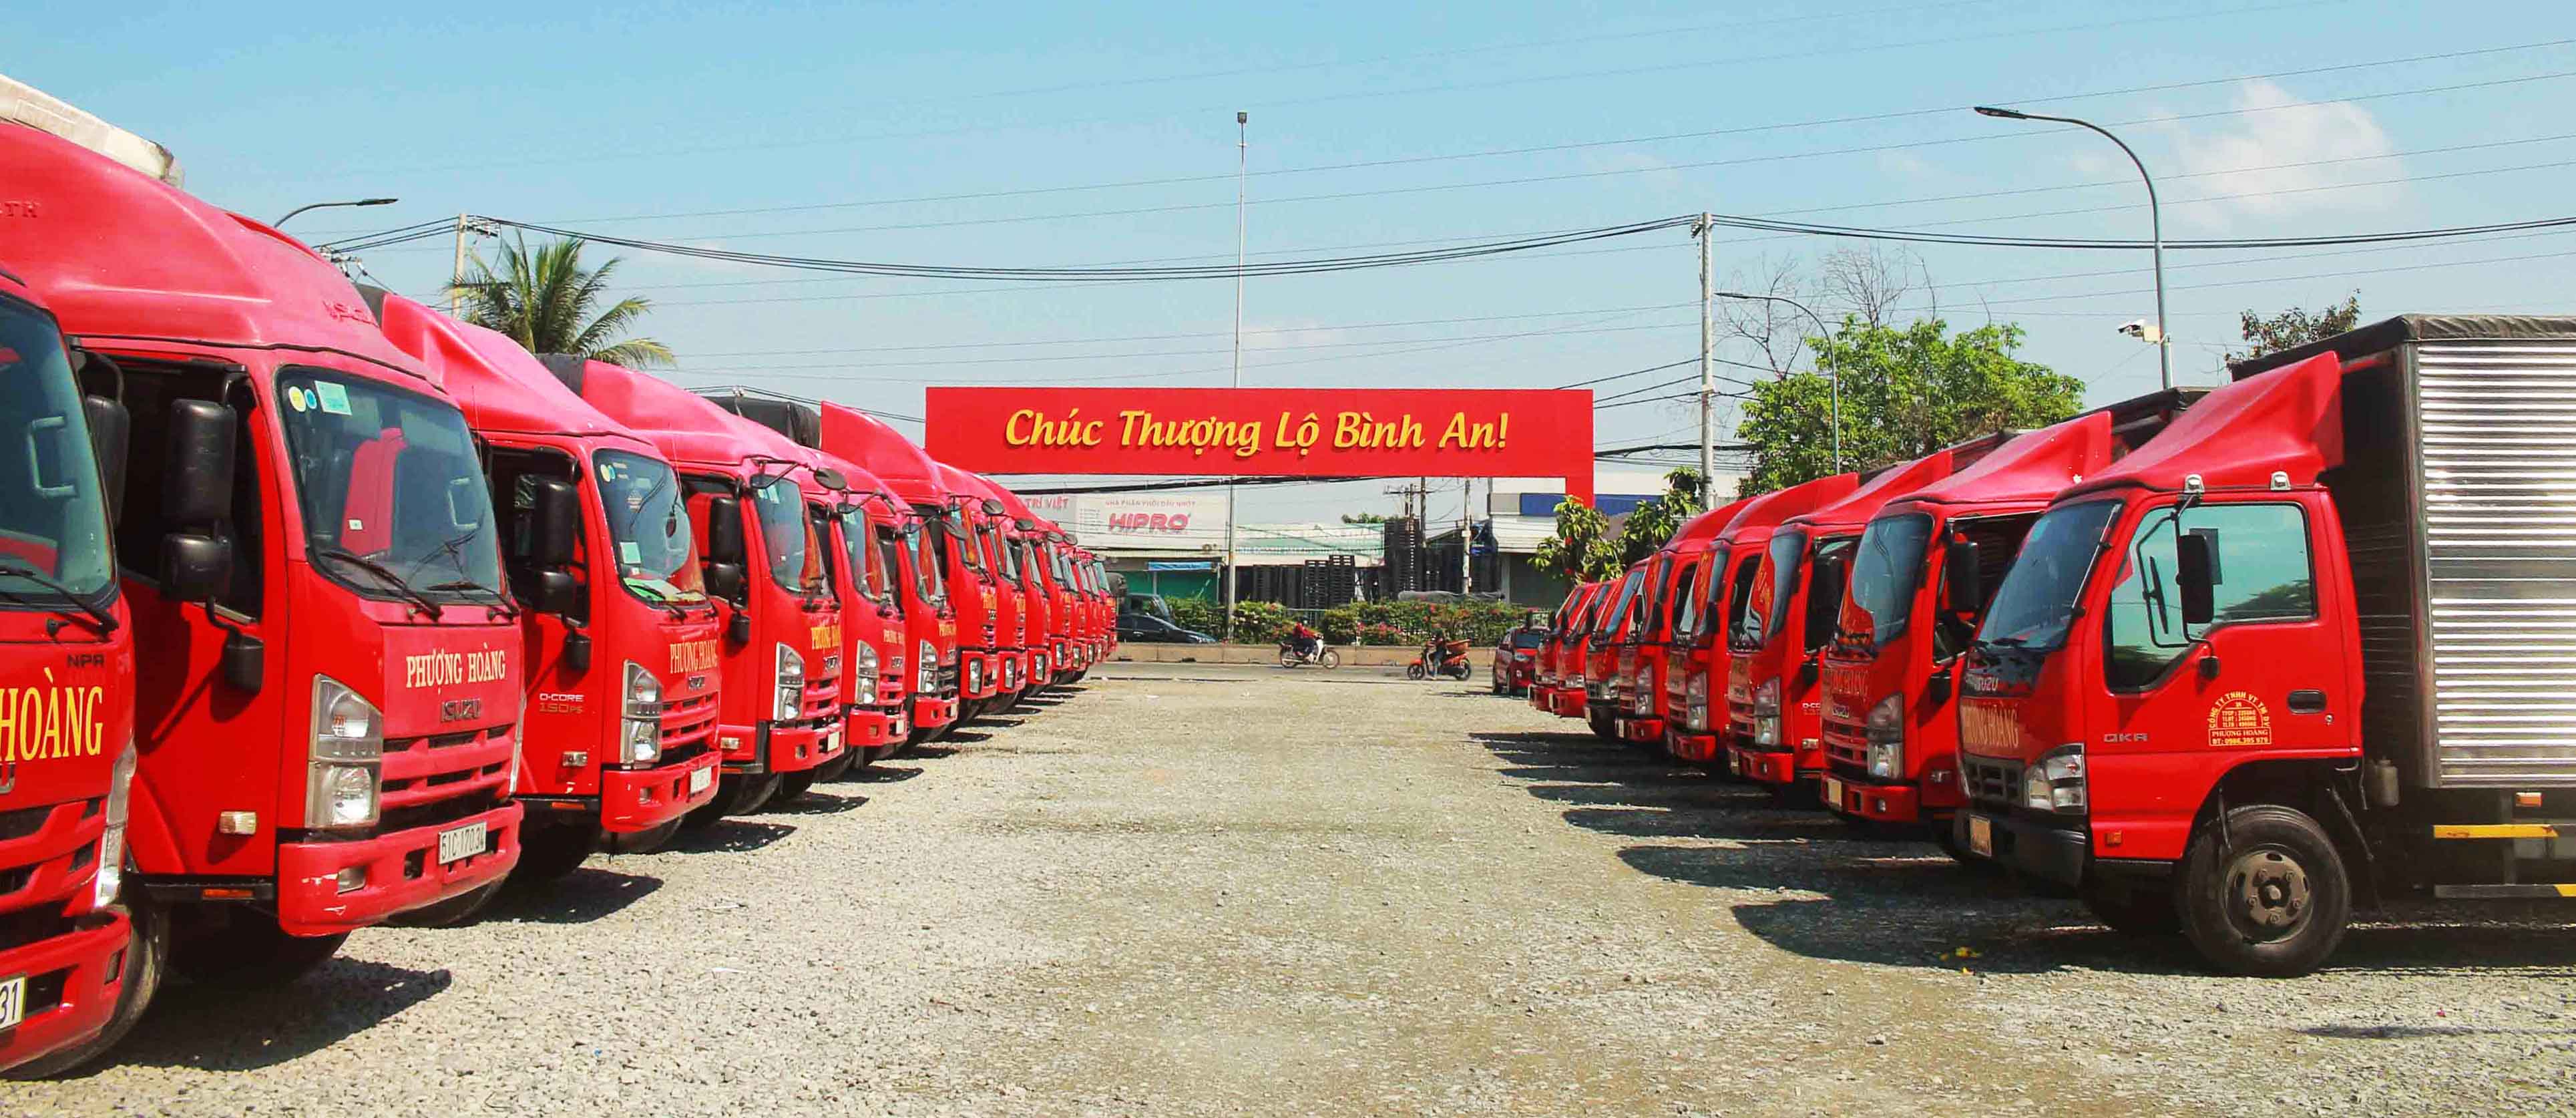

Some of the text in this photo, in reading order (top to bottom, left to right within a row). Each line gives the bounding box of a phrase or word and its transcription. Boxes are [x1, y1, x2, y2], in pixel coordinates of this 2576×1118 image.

[1006, 408, 1509, 457] Chúc Thượng Lộ Bình An!
[1108, 513, 1189, 531] HIPRO
[67, 654, 105, 667] NPR
[406, 641, 506, 695] PHƯỢNG HOÀNG
[0, 667, 103, 761] HOÀNG
